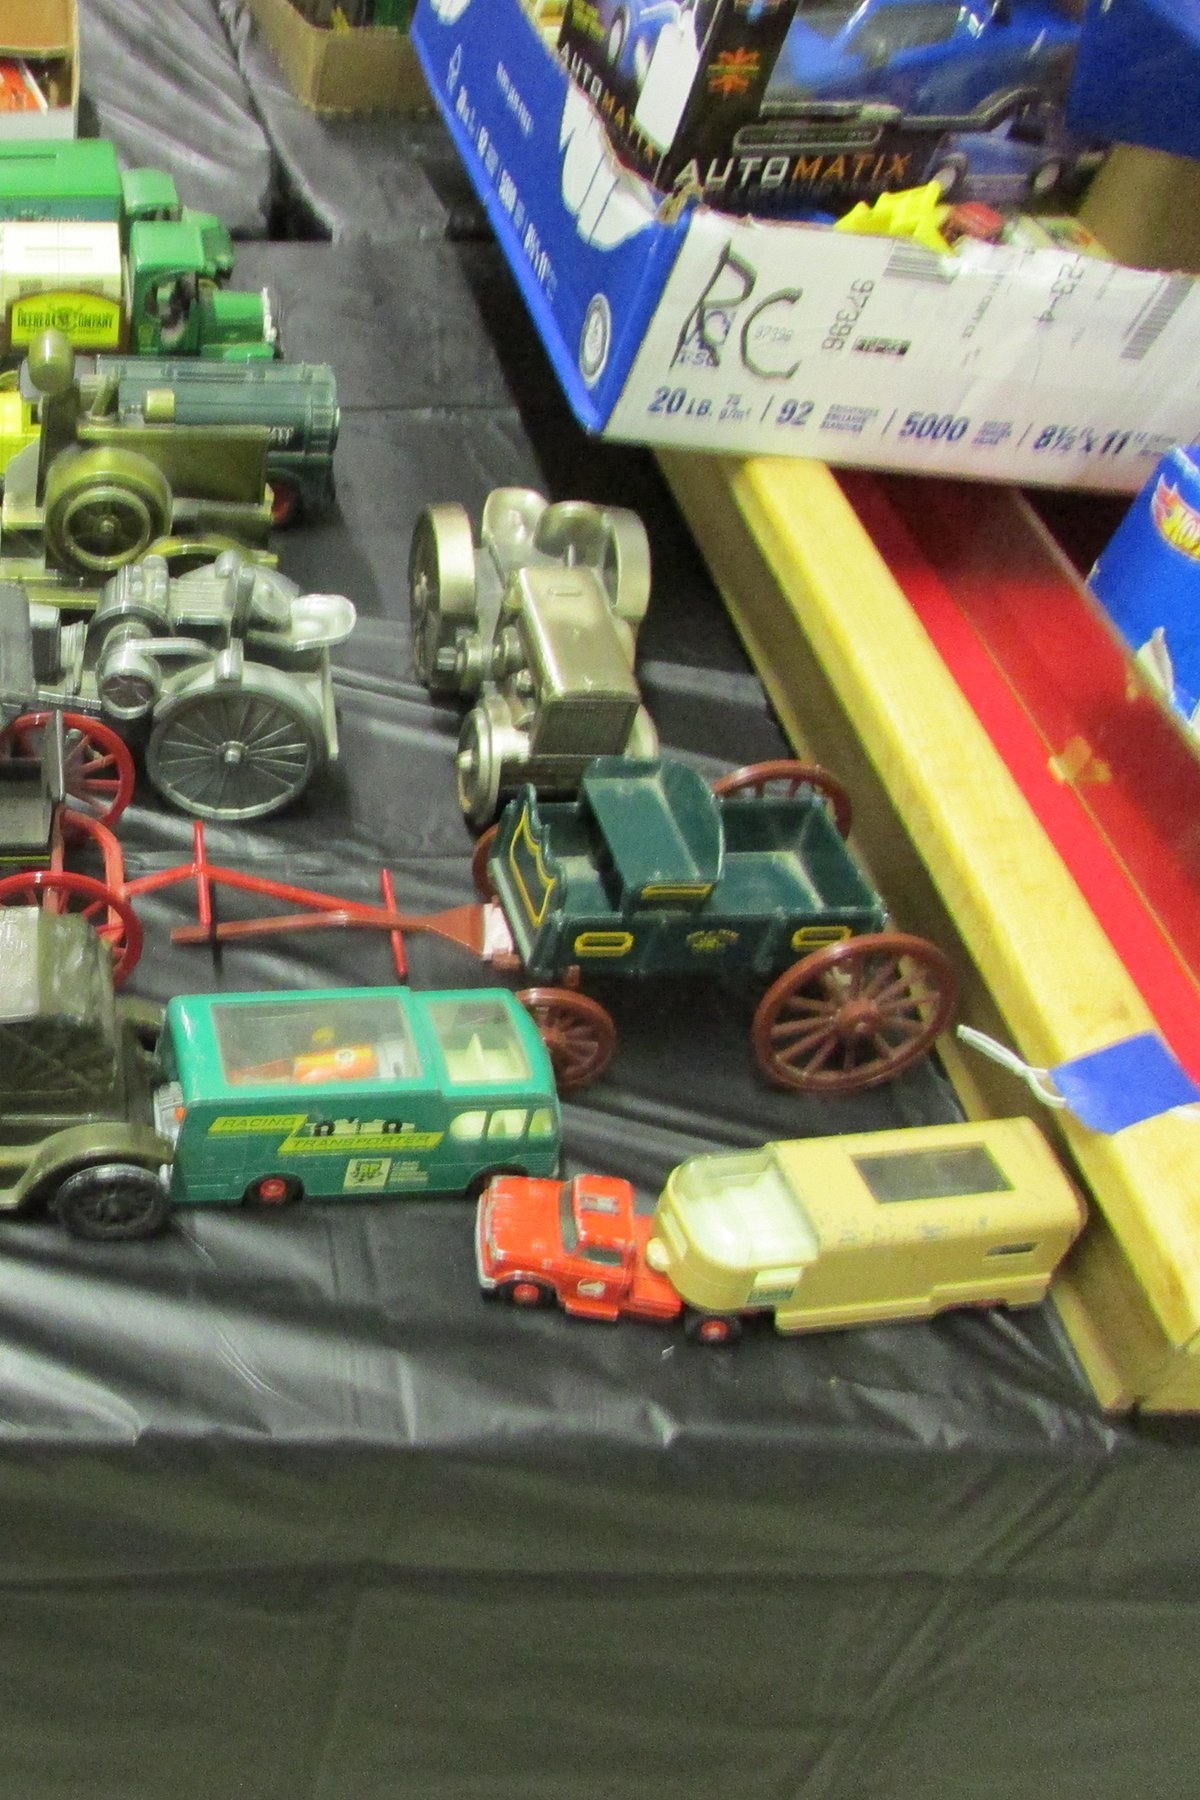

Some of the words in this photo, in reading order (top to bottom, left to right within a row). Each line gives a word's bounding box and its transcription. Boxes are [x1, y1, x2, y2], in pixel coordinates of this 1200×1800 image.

[673, 152, 912, 192] AUTOMATIX
[668, 238, 803, 382] RC
[648, 386, 688, 416] 20
[776, 399, 816, 426] 92
[899, 410, 970, 442] 5000
[223, 1117, 297, 1128] RACING
[293, 1134, 432, 1148] TRANSPORTER
